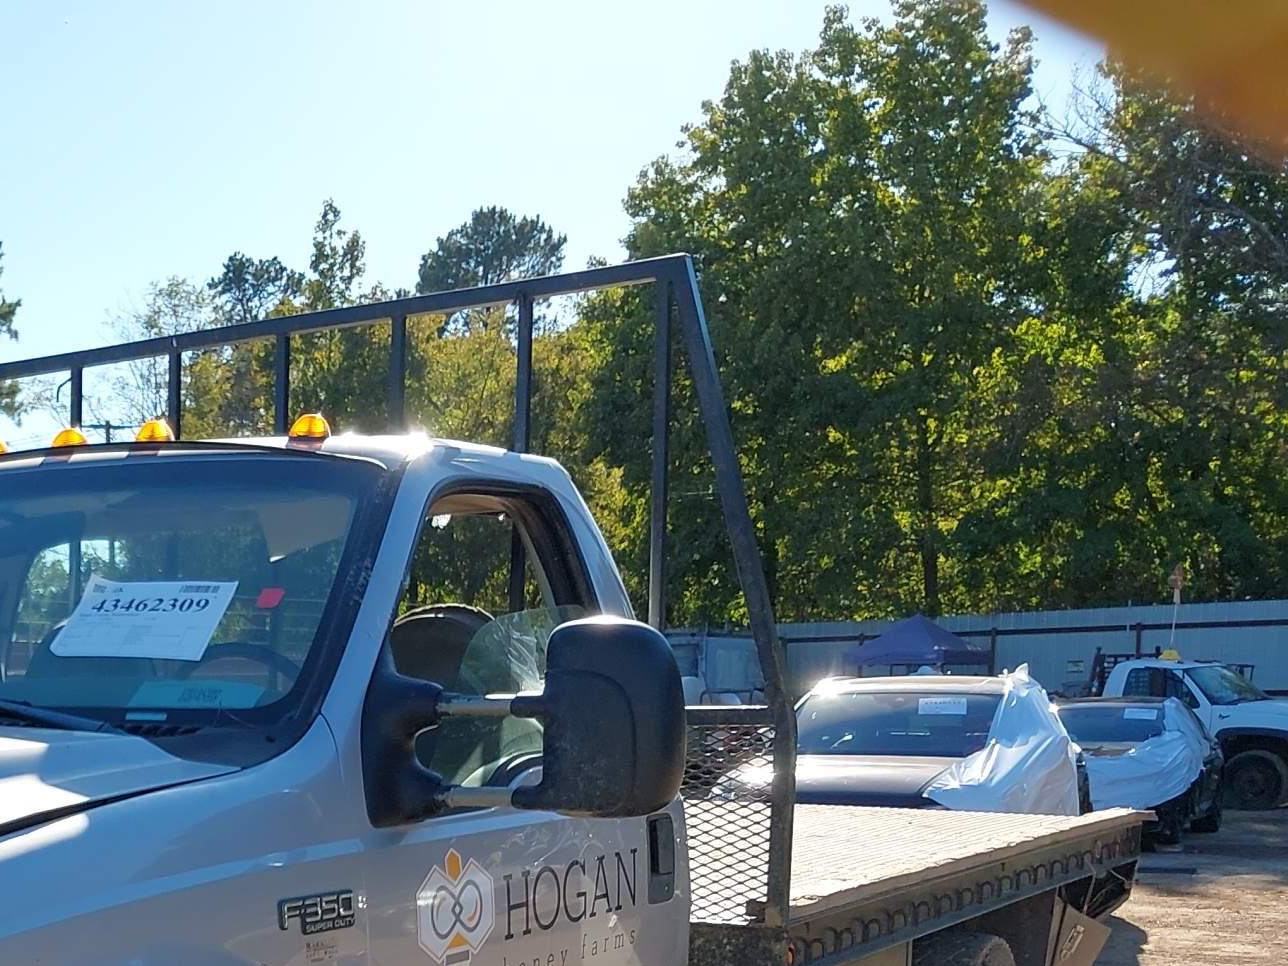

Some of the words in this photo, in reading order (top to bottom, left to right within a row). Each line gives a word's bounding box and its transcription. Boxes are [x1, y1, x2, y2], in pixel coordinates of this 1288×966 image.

[92, 598, 210, 613] 43462309
[503, 848, 638, 941] HOGAN
[306, 920, 333, 933] SUPER
[334, 918, 356, 928] DUTY
[581, 928, 637, 960] farms
